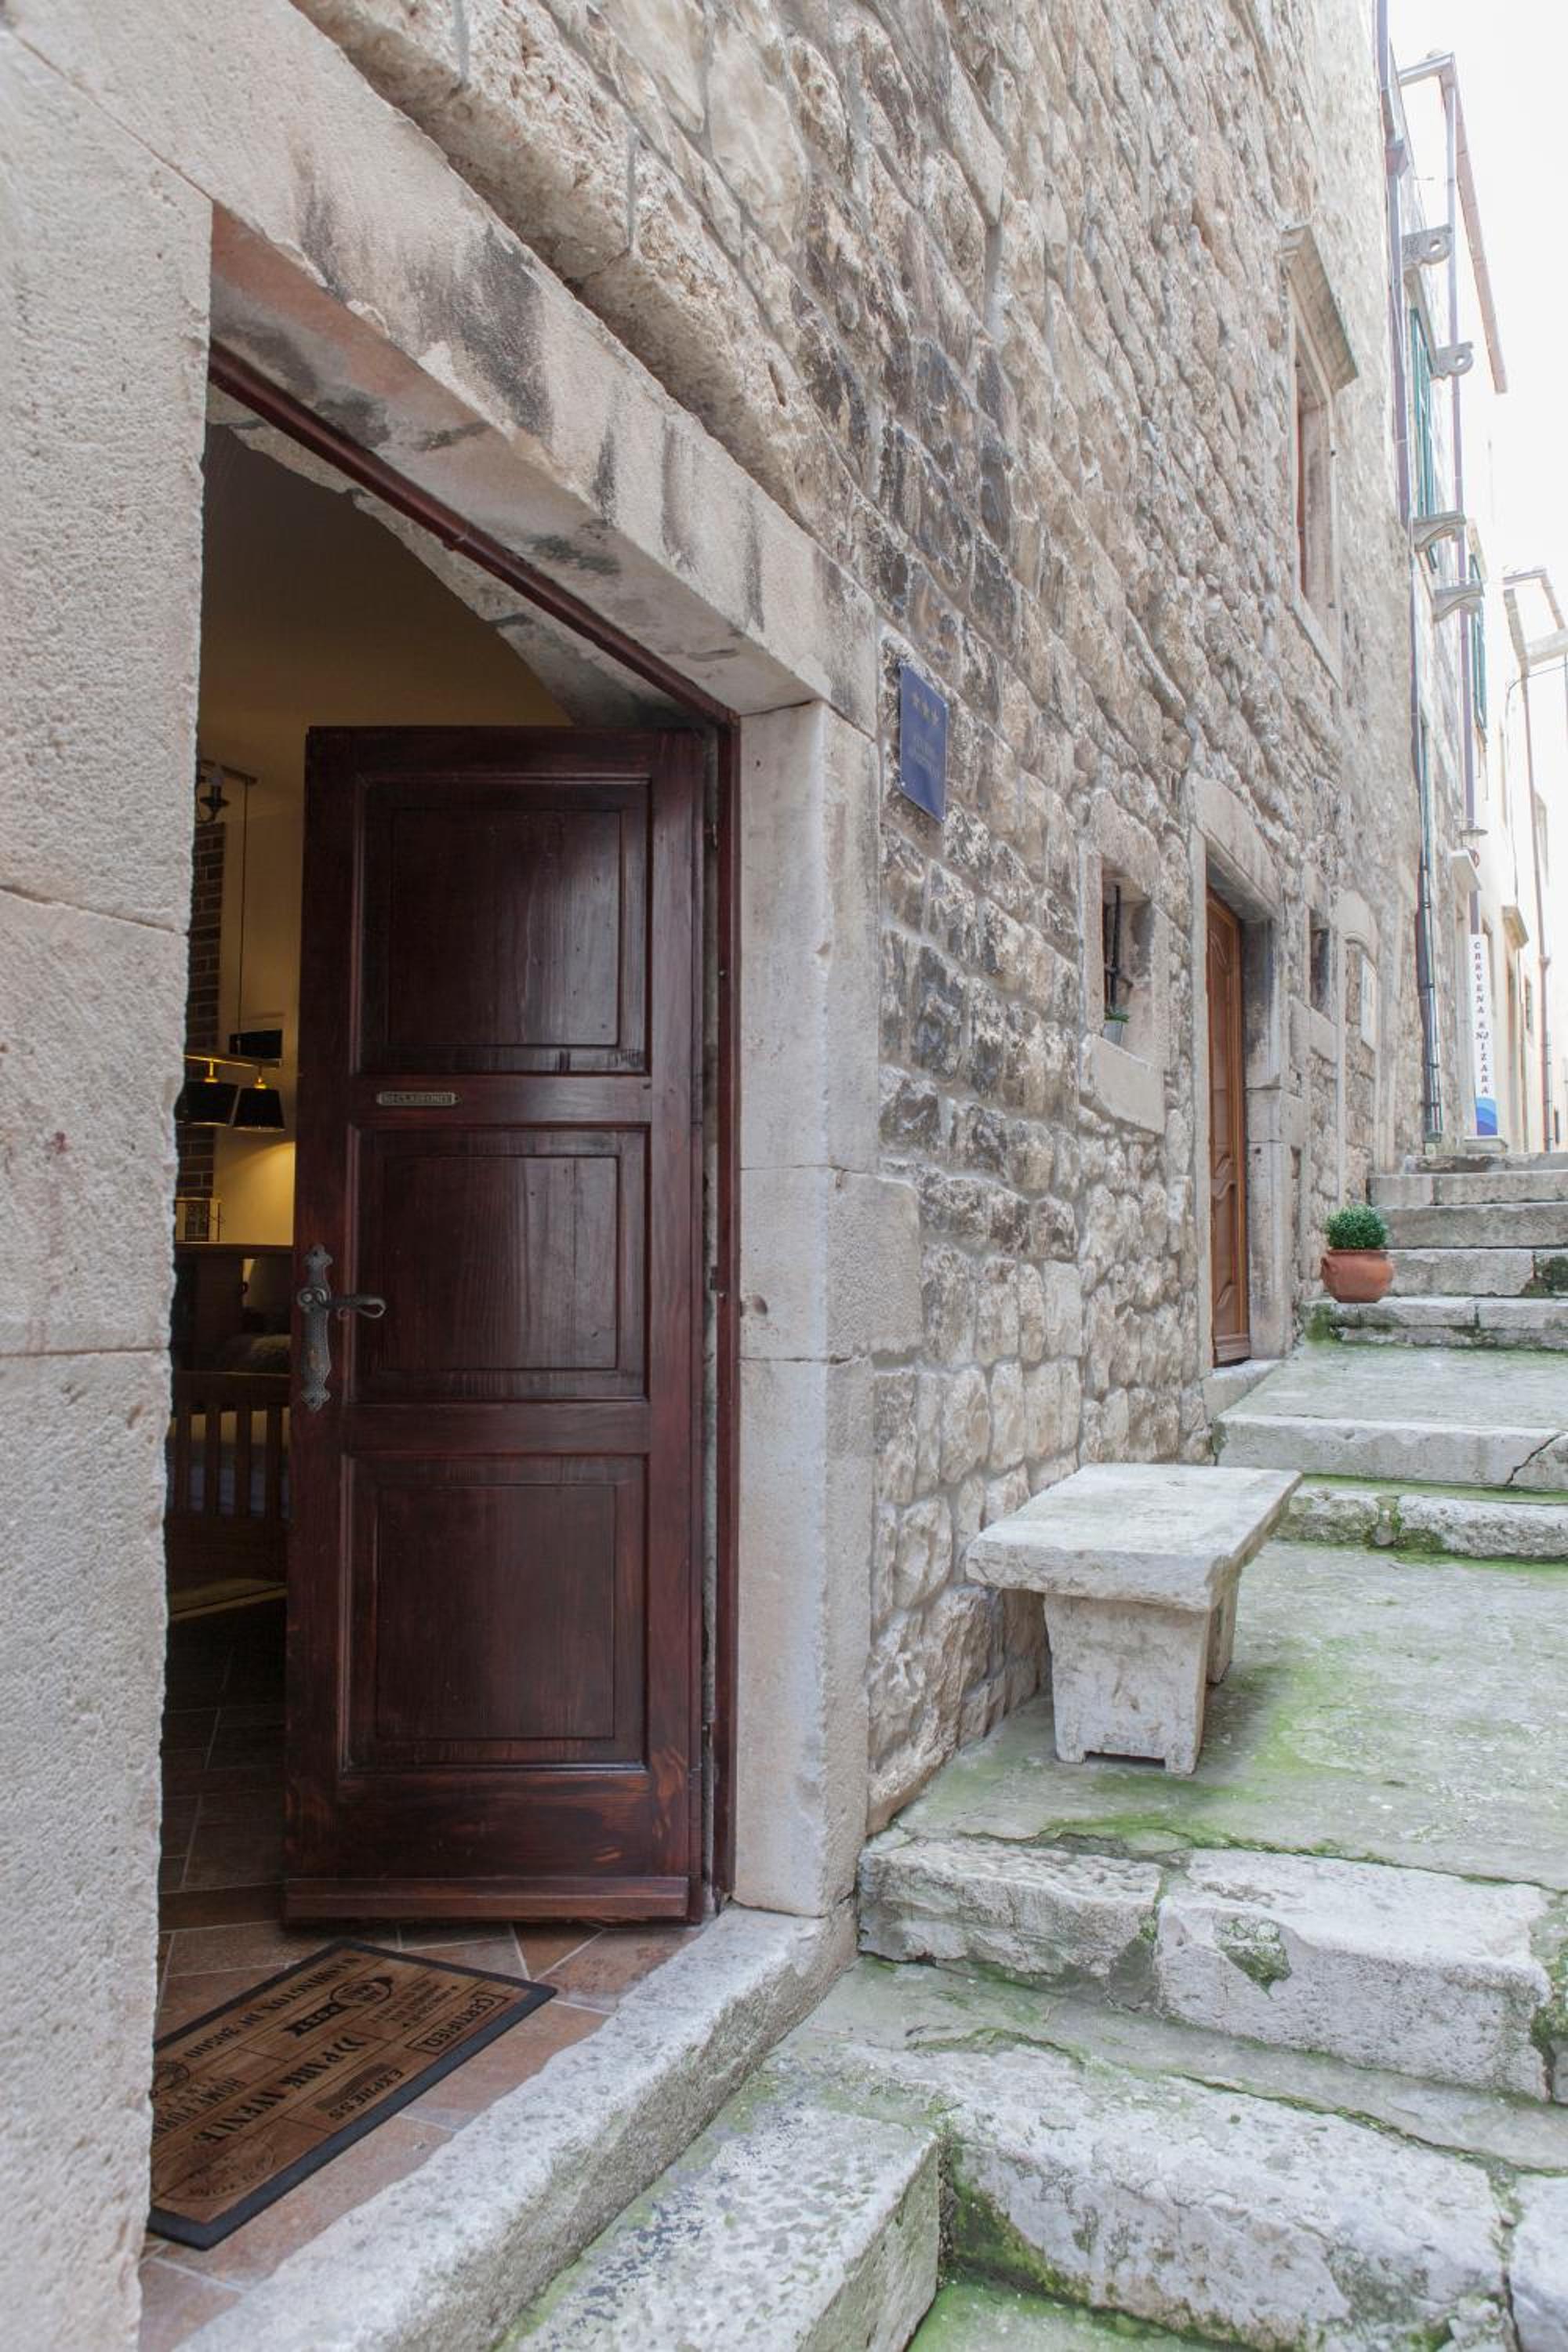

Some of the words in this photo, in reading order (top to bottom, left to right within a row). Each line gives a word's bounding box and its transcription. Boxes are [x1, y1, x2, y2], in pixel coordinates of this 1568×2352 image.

[422, 1998, 495, 2048] CERTIFIED
[198, 2077, 246, 2107] HOME
[278, 2049, 346, 2089] PARK
[193, 2090, 288, 2145] AVENUE
[328, 2068, 405, 2121] EXPRESS
